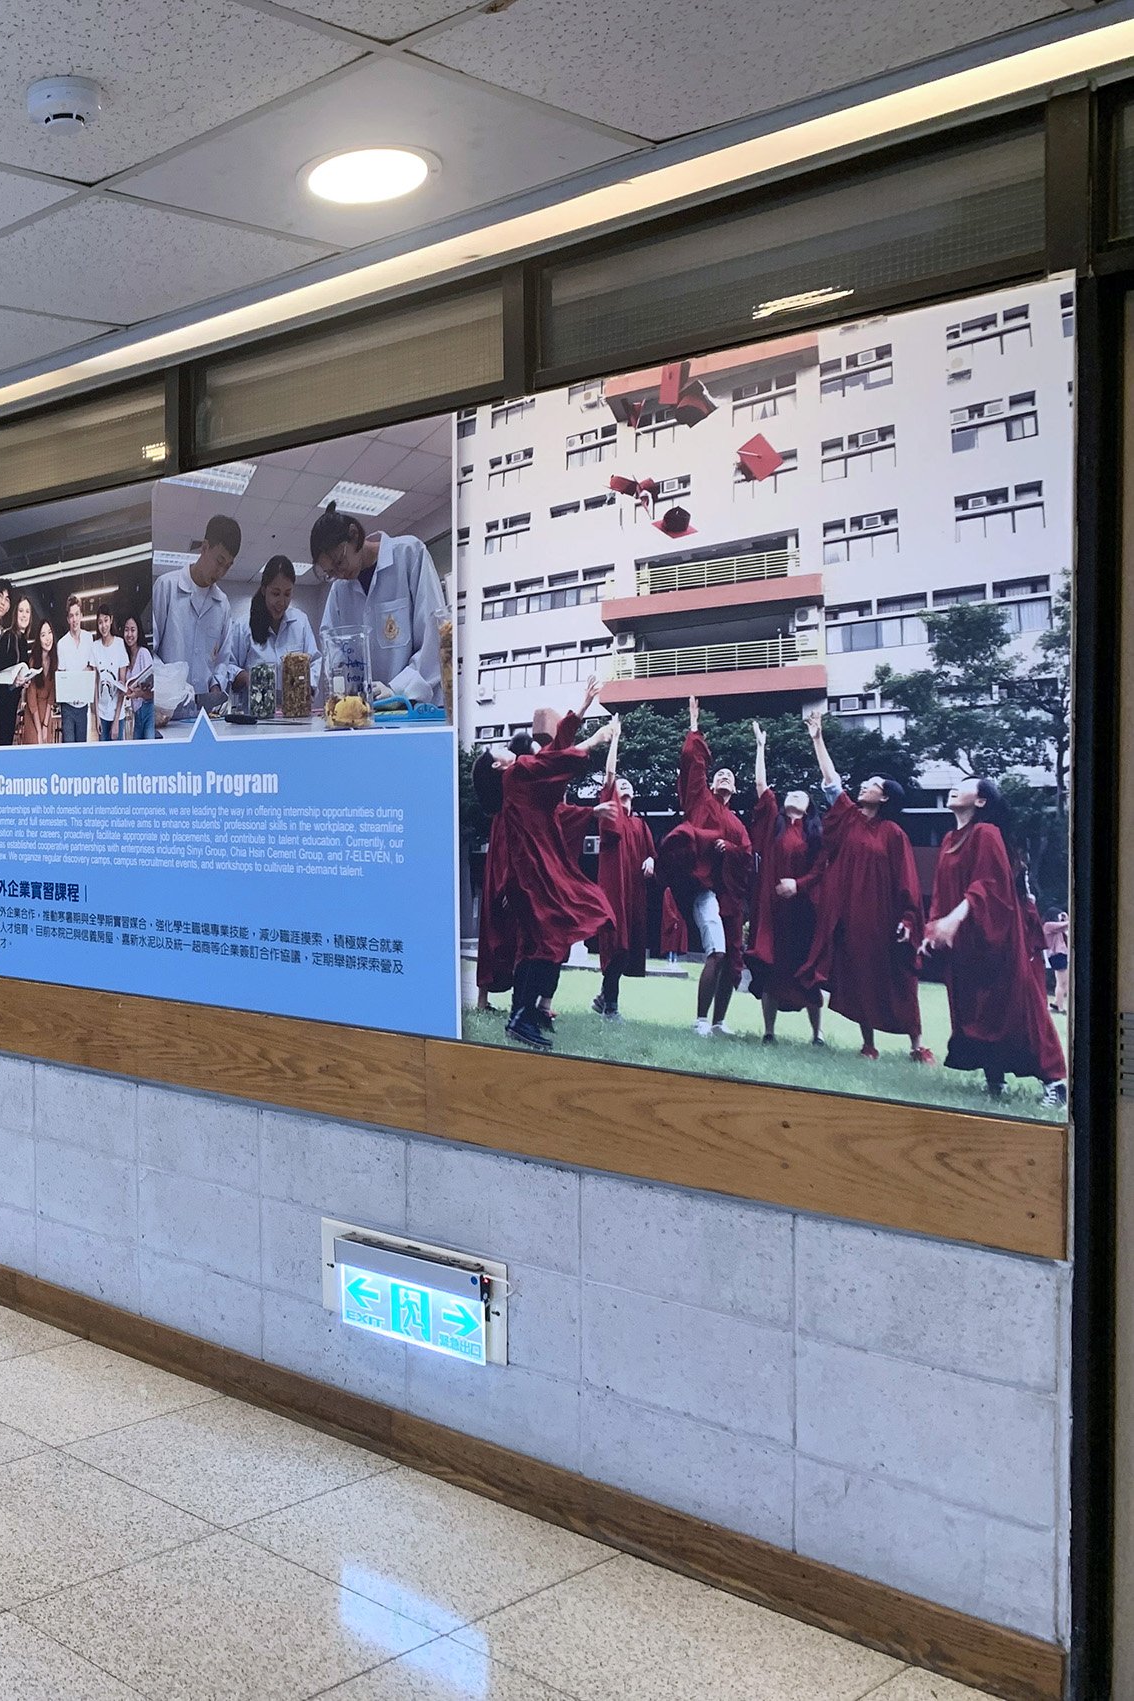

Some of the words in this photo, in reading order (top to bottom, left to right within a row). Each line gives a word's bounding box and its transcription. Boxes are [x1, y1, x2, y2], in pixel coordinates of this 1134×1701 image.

[51, 773, 119, 797] Corporate
[123, 770, 203, 797] Internship
[206, 770, 279, 796] Program
[31, 805, 42, 814] with
[43, 805, 56, 815] both
[56, 805, 82, 815] domestic
[82, 806, 94, 815] and
[94, 806, 130, 816] international
[132, 806, 167, 818] companies,
[168, 808, 178, 816] we
[180, 808, 190, 816] are
[192, 806, 216, 818] leading
[218, 806, 228, 816] the
[230, 808, 246, 818] way
[246, 806, 253, 816] in
[254, 806, 282, 819] offering
[282, 806, 320, 818] internship
[322, 806, 374, 820] opportunities
[376, 807, 404, 820] during
[18, 818, 28, 826] and
[30, 817, 38, 826] full
[39, 818, 68, 827] semesters.
[70, 817, 83, 828] This
[84, 818, 109, 829] strategic
[110, 818, 136, 828] initiative
[136, 818, 152, 828] aims
[154, 819, 160, 828] to
[162, 819, 190, 829] enhance
[224, 819, 266, 832] professional
[269, 820, 288, 831] skills
[290, 820, 297, 831] in
[299, 820, 312, 832] the
[314, 821, 356, 834] workplace,
[360, 822, 404, 833] streamline
[15, 828, 25, 838] into
[26, 828, 38, 838] their
[40, 830, 62, 840] careers,
[64, 830, 94, 841] proactively
[96, 830, 120, 840] facilitate
[122, 832, 158, 843] appropriate
[160, 832, 170, 844] job
[172, 832, 212, 844] placements,
[214, 832, 228, 844] and
[230, 833, 266, 844] contribute
[268, 834, 276, 844] to
[278, 834, 300, 846] talent
[302, 836, 342, 847] education.
[346, 836, 386, 850] Currently,
[389, 838, 404, 848] our
[7, 840, 36, 850] established
[38, 842, 69, 852] cooperative
[70, 842, 106, 854] partnerships
[107, 843, 120, 852] with
[120, 844, 156, 855] enterprises
[156, 845, 186, 858] including
[186, 845, 204, 858] Sinyi
[206, 845, 228, 858] Group,
[230, 846, 246, 857] Chia
[248, 846, 265, 858] Hsin
[267, 847, 297, 860] Cement
[298, 848, 325, 862] Group,
[327, 850, 342, 862] and
[345, 850, 393, 864] 7-ELEVEN,
[396, 853, 404, 864] to
[8, 852, 18, 860] We
[18, 852, 42, 864] organize
[42, 853, 62, 864] regular
[63, 854, 90, 866] discovery
[91, 856, 112, 866] camps,
[114, 857, 138, 868] campus
[138, 857, 174, 868] recruitment
[175, 860, 200, 870] events,
[200, 860, 214, 870] and
[216, 860, 253, 873] workshops
[254, 862, 262, 872] to
[264, 862, 294, 874] cultivate
[296, 864, 338, 876] in-demand
[340, 865, 364, 877] talent.
[346, 1309, 385, 1328] EXIT
[438, 1332, 481, 1358] 緊急出口
